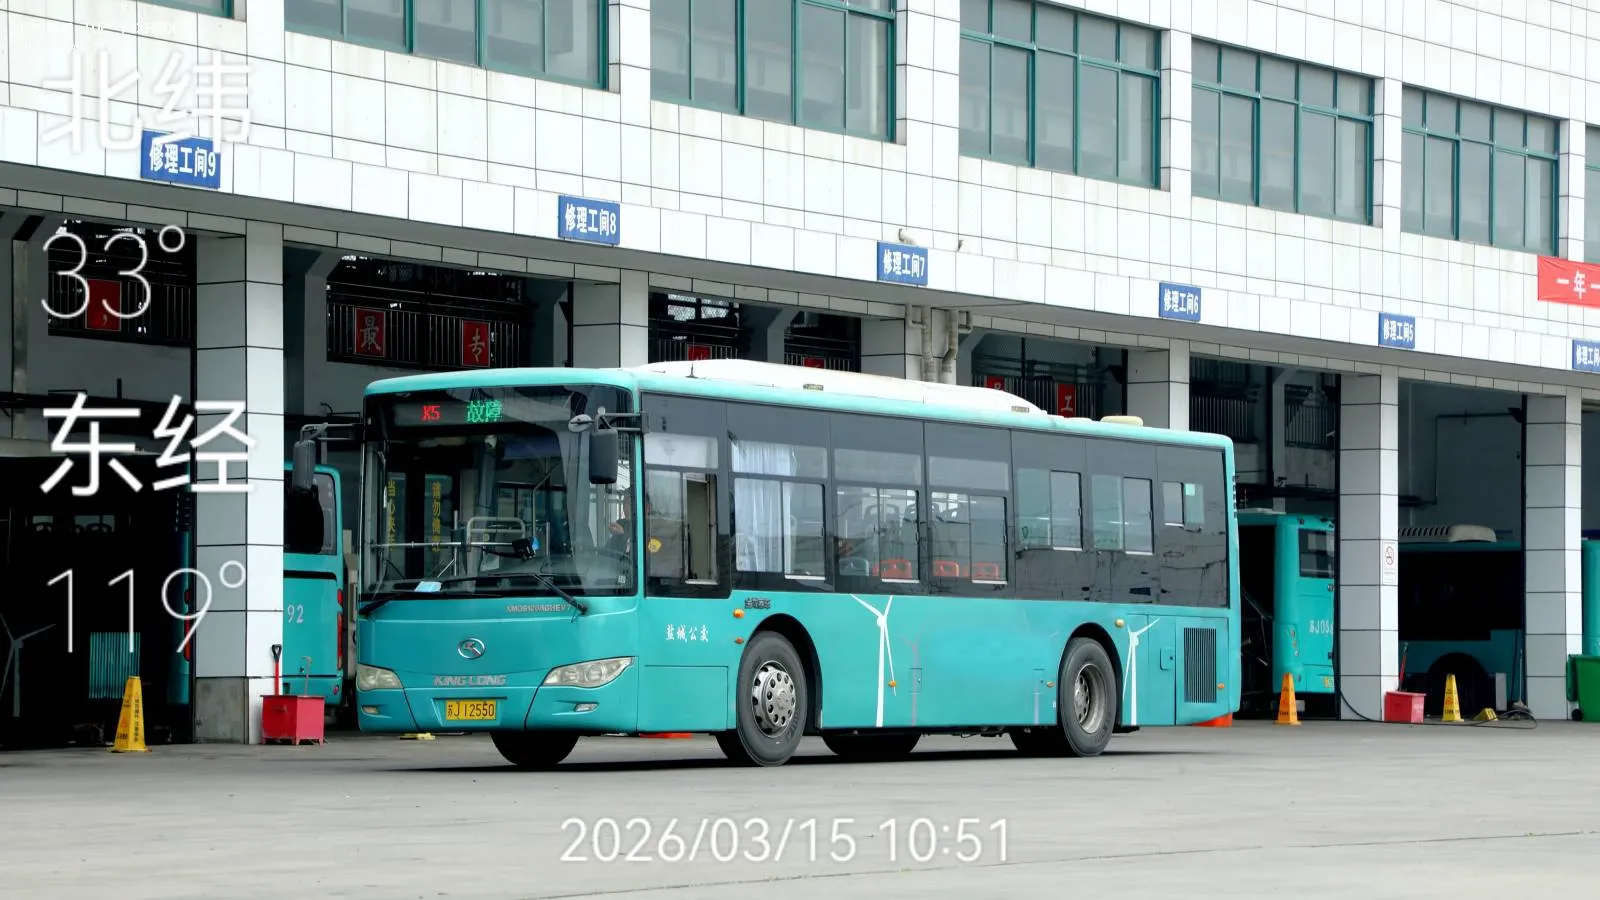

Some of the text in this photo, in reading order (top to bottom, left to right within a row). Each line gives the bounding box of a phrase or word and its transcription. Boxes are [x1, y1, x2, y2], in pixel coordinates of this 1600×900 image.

[150, 144, 217, 178] 修理工间9
[564, 202, 617, 235] 修理工间8
[883, 248, 926, 280] 修理工间7
[1163, 288, 1200, 314] 修理工间6
[360, 315, 381, 351] 最
[1383, 319, 1414, 343] 修理工间5
[1576, 344, 1600, 367] 修理工间
[466, 400, 503, 423] 故障
[287, 604, 304, 624] 92
[666, 623, 709, 644] 盐城公交
[434, 674, 507, 686] KING LONG
